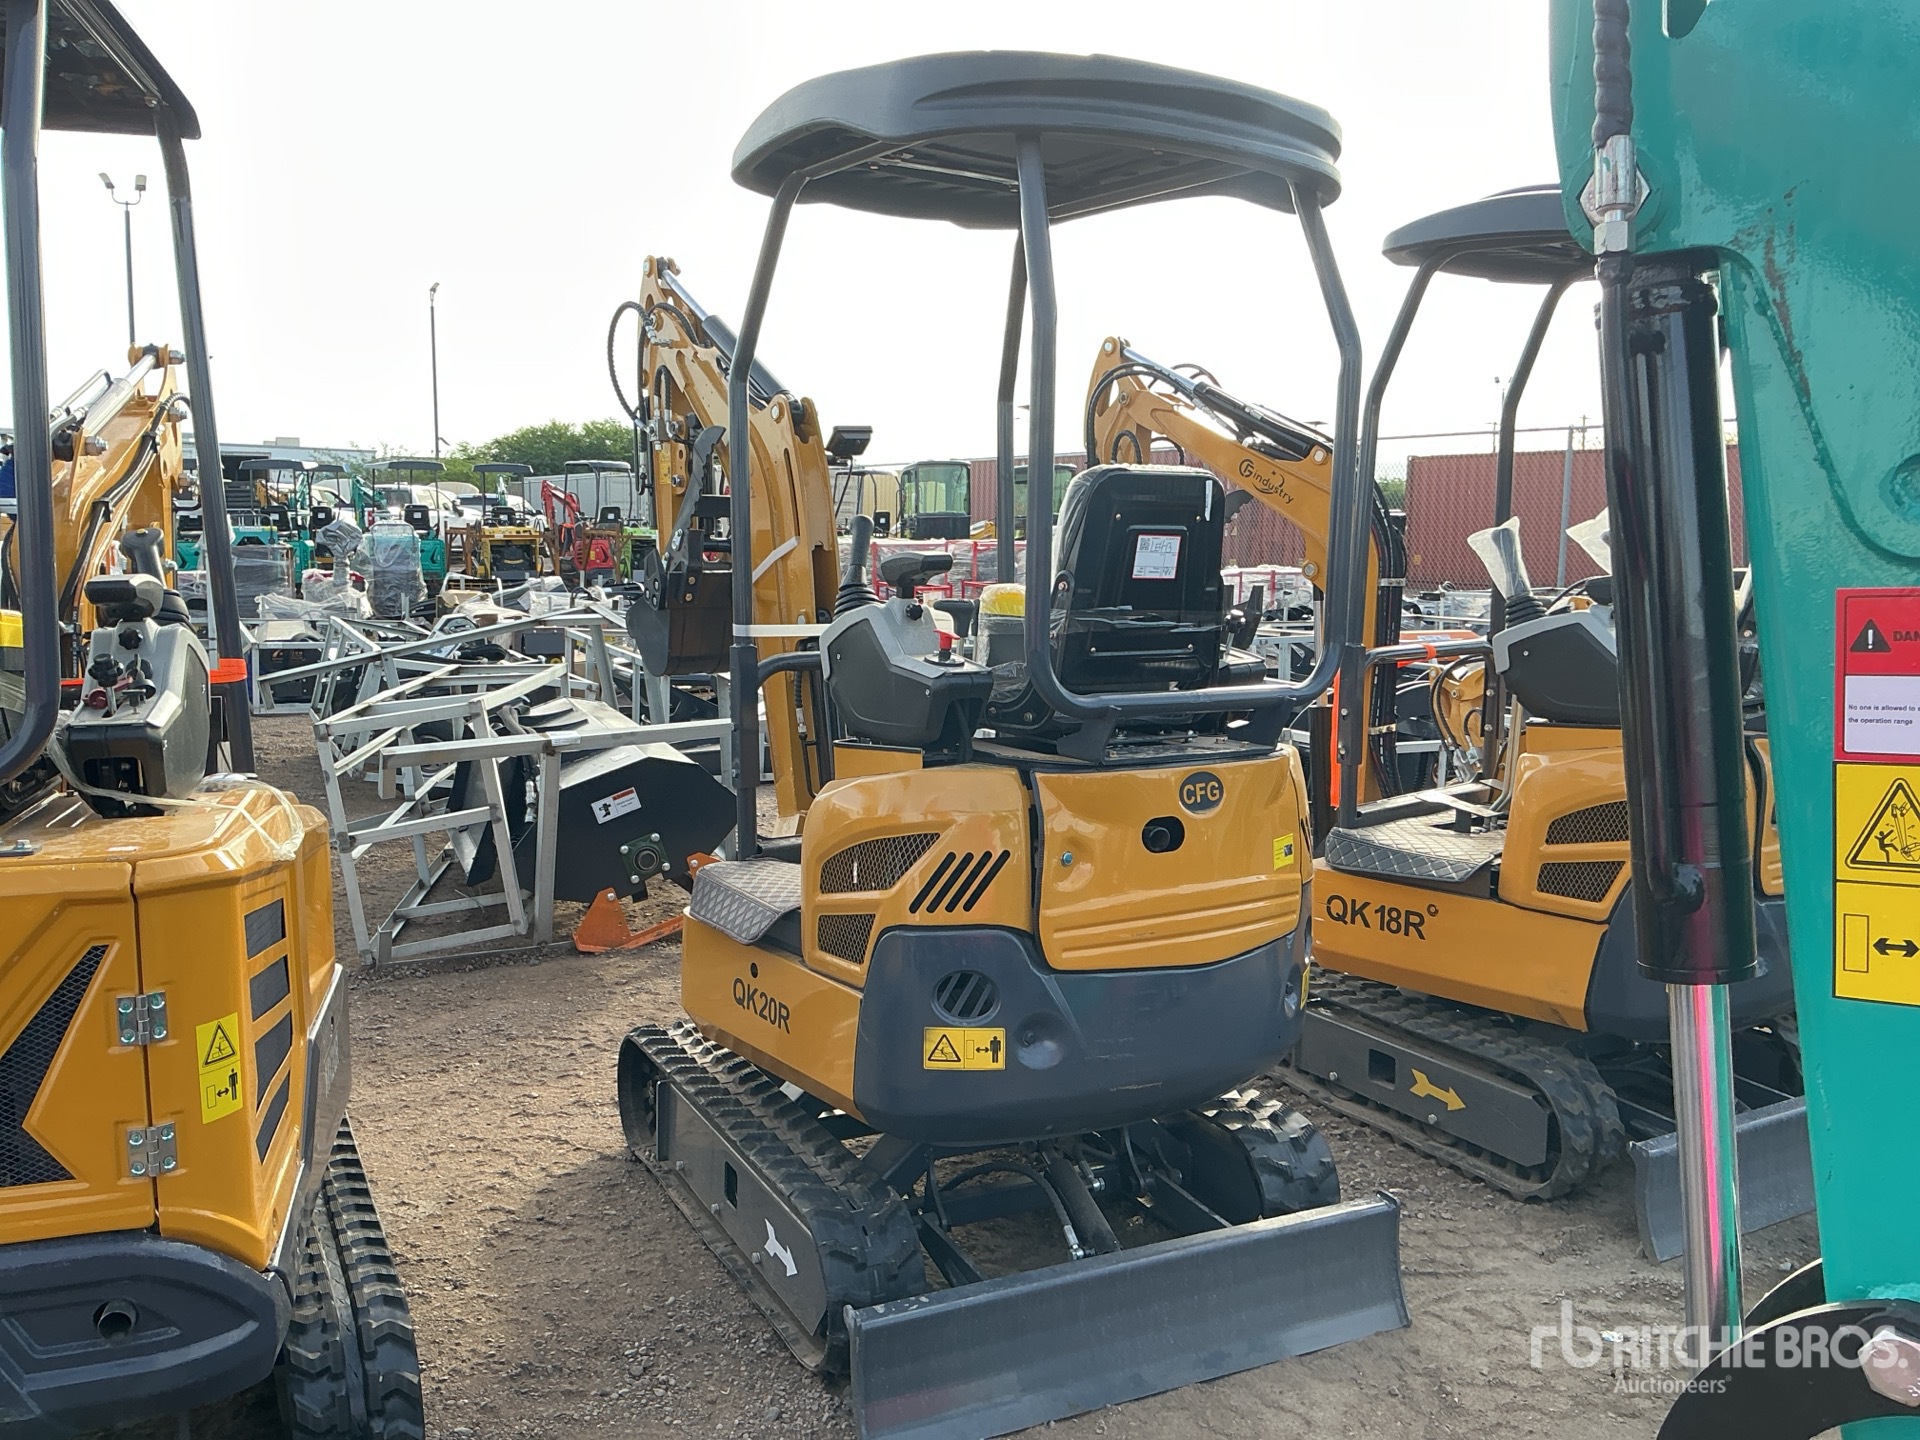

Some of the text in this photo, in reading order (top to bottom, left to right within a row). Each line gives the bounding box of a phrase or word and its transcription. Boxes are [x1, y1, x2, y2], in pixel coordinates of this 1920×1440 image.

[1908, 704, 1916, 712] to
[1182, 781, 1220, 805] CFG
[1326, 894, 1426, 941] QK18R
[733, 977, 790, 1035] QK20R
